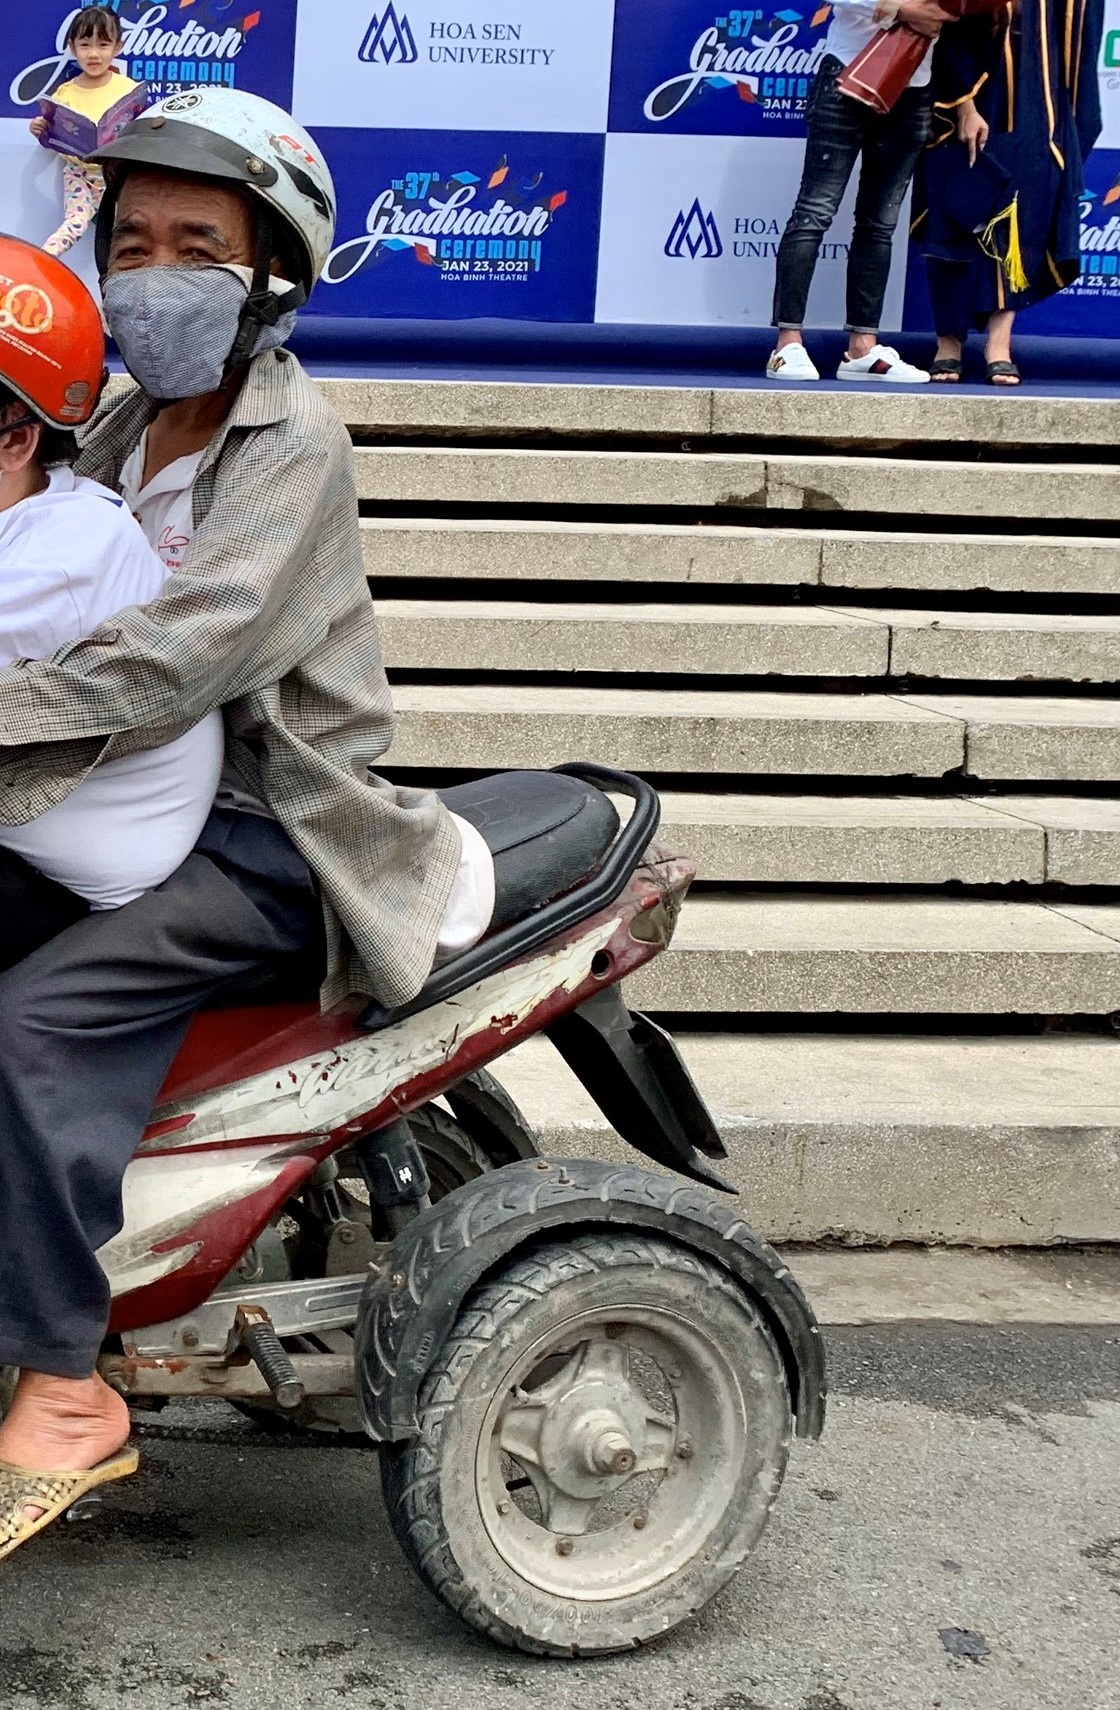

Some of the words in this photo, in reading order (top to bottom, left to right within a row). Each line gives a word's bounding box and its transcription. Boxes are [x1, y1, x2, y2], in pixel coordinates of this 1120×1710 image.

[429, 22, 477, 40] HOA
[482, 24, 522, 40] SEN
[428, 46, 556, 66] UNIVERSITY
[132, 60, 235, 89] ceremony
[763, 77, 808, 97] cere
[764, 98, 791, 110] JAN
[391, 179, 404, 190] THE
[320, 186, 549, 284] Graduation
[734, 218, 780, 235] HOA
[441, 239, 542, 272] ceremony
[733, 241, 851, 260] UNIVITY
[442, 260, 470, 272] JAN
[474, 261, 493, 272] 23,
[497, 261, 528, 272] 2021
[489, 274, 528, 282] THEATRE
[1088, 276, 1106, 288] 23,
